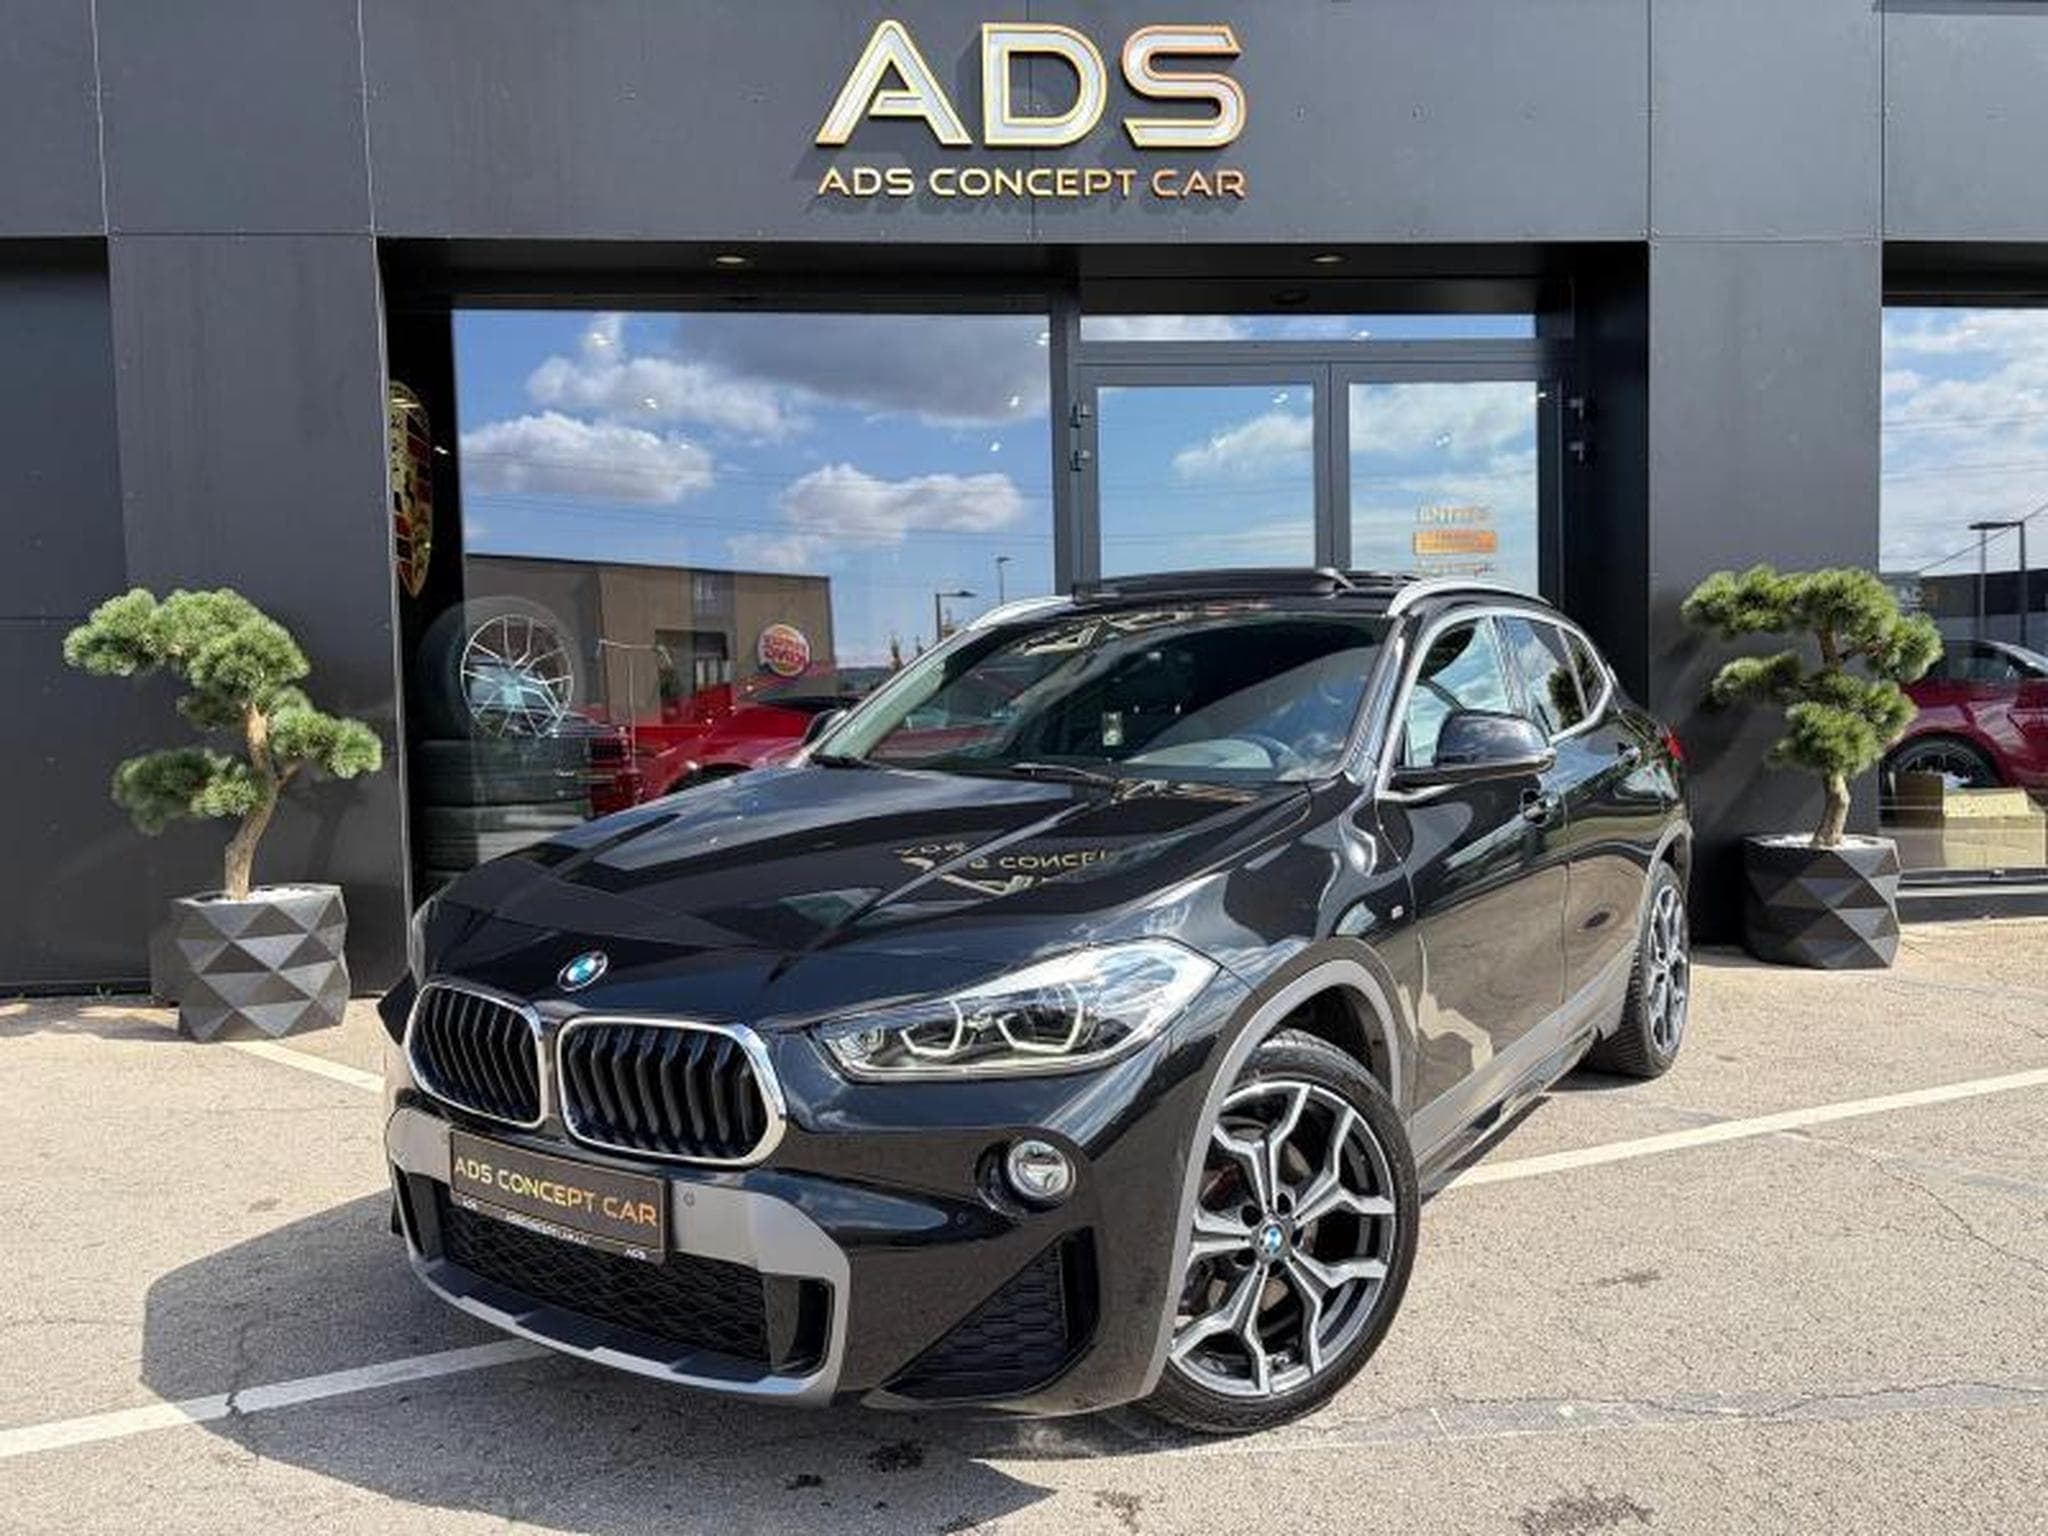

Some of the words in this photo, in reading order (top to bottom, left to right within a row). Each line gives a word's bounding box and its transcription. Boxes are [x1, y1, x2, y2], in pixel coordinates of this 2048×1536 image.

[815, 19, 1247, 148] ADS
[817, 167, 915, 196] ADS
[929, 167, 1137, 197] CONCEPT
[1152, 169, 1247, 199] CAR
[454, 1157, 493, 1184] ADS
[498, 1169, 595, 1213] CONCEPT
[603, 1197, 657, 1227] CAR
